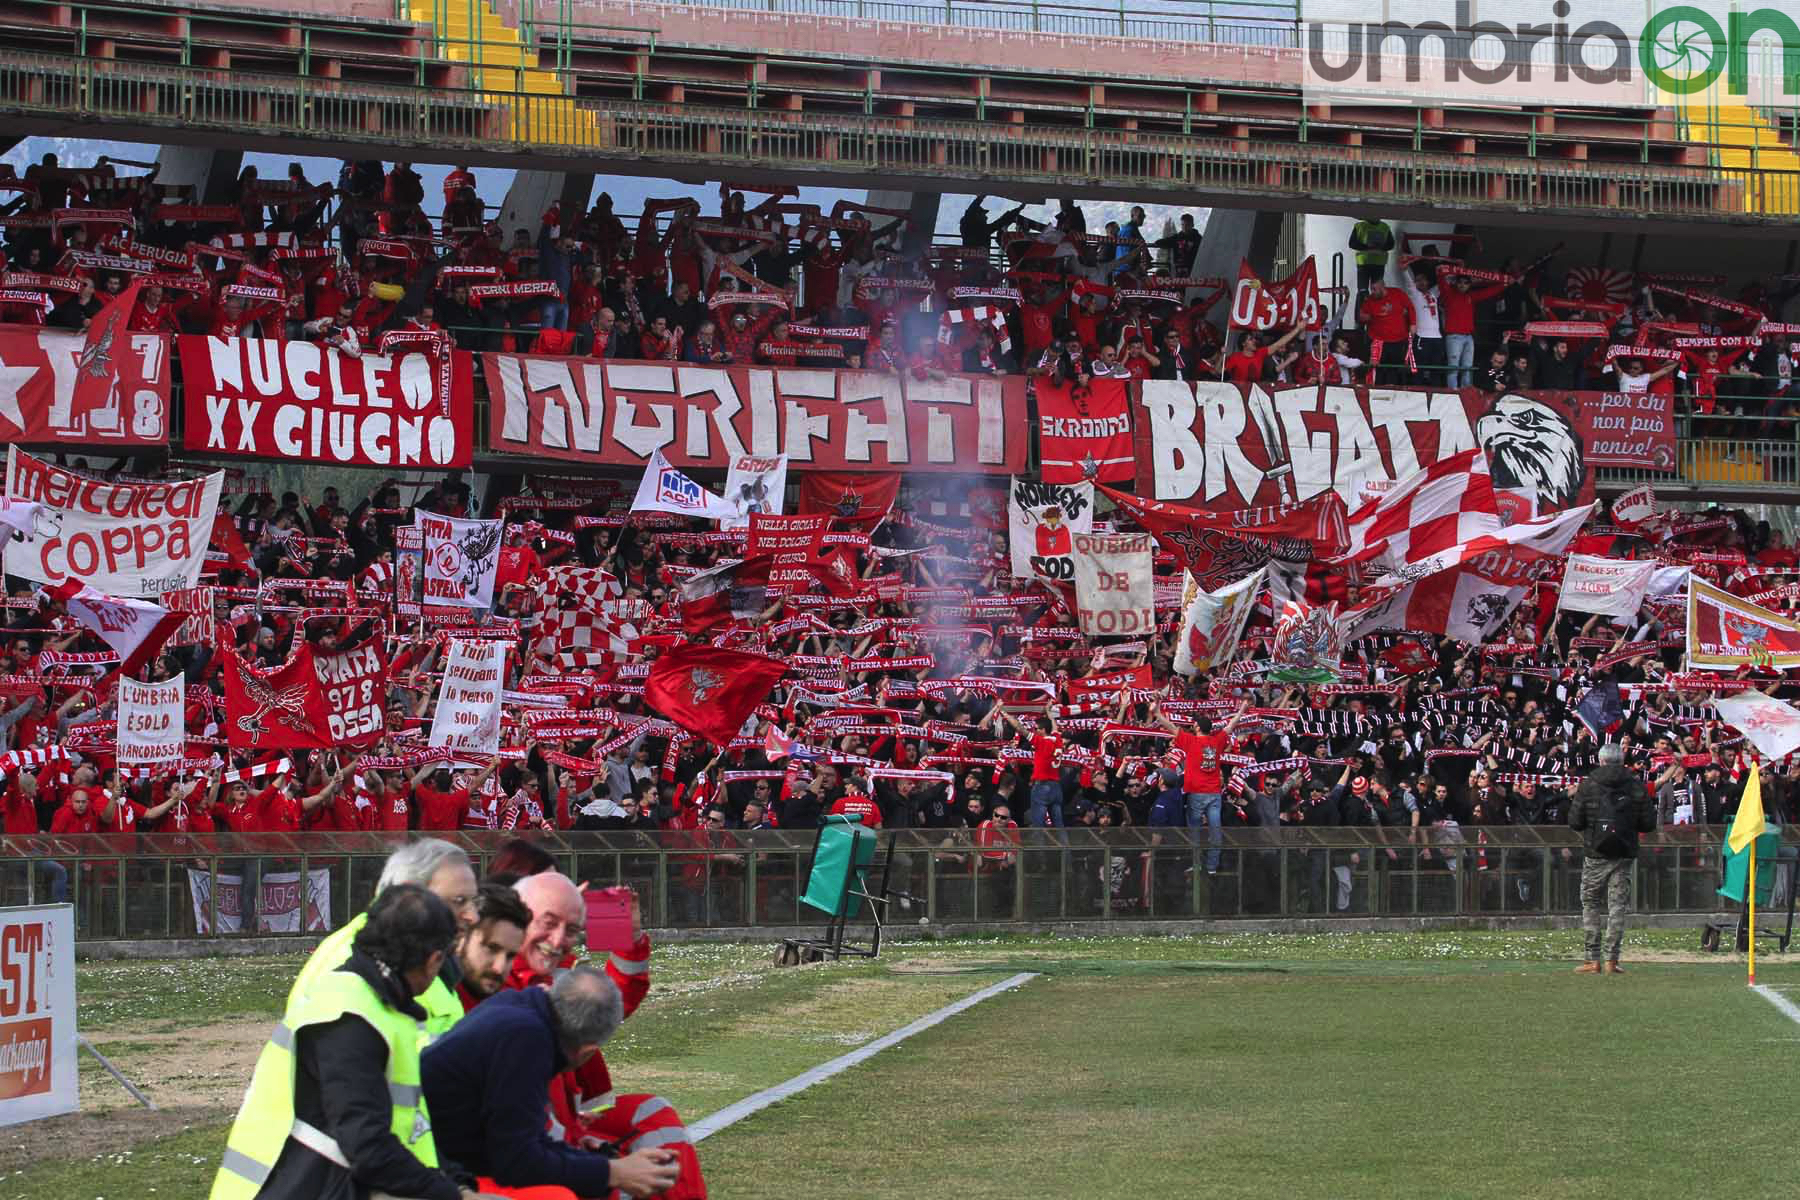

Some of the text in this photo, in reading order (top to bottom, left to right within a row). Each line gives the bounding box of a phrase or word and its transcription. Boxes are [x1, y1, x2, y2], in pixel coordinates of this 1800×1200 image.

[130, 241, 188, 265] PERUGIA
[229, 284, 279, 298] PERUGIA
[513, 282, 557, 294] MERDA
[1675, 335, 1717, 347] SEMPRE
[1720, 335, 1739, 346] CON
[206, 335, 433, 412] NUCLEO
[497, 354, 1005, 466] INGRIFATI
[1636, 392, 1665, 412] chi
[206, 395, 456, 466] XX GIUGNO
[1592, 415, 1626, 430] non
[1013, 482, 1089, 521] MONKEYS
[757, 518, 789, 531] NELLA
[40, 519, 191, 580] coppa
[757, 536, 778, 548] NEL
[778, 535, 813, 548] DOLORE
[140, 573, 188, 593] perugia
[780, 569, 811, 582] AMOR
[1096, 571, 1130, 593] DE
[434, 613, 468, 625] PERUGIA
[1079, 607, 1153, 633] TODI
[313, 644, 381, 685] RMATA
[122, 685, 180, 706] L'UMBRIA
[135, 713, 171, 732] SOLO
[454, 710, 479, 726] solo
